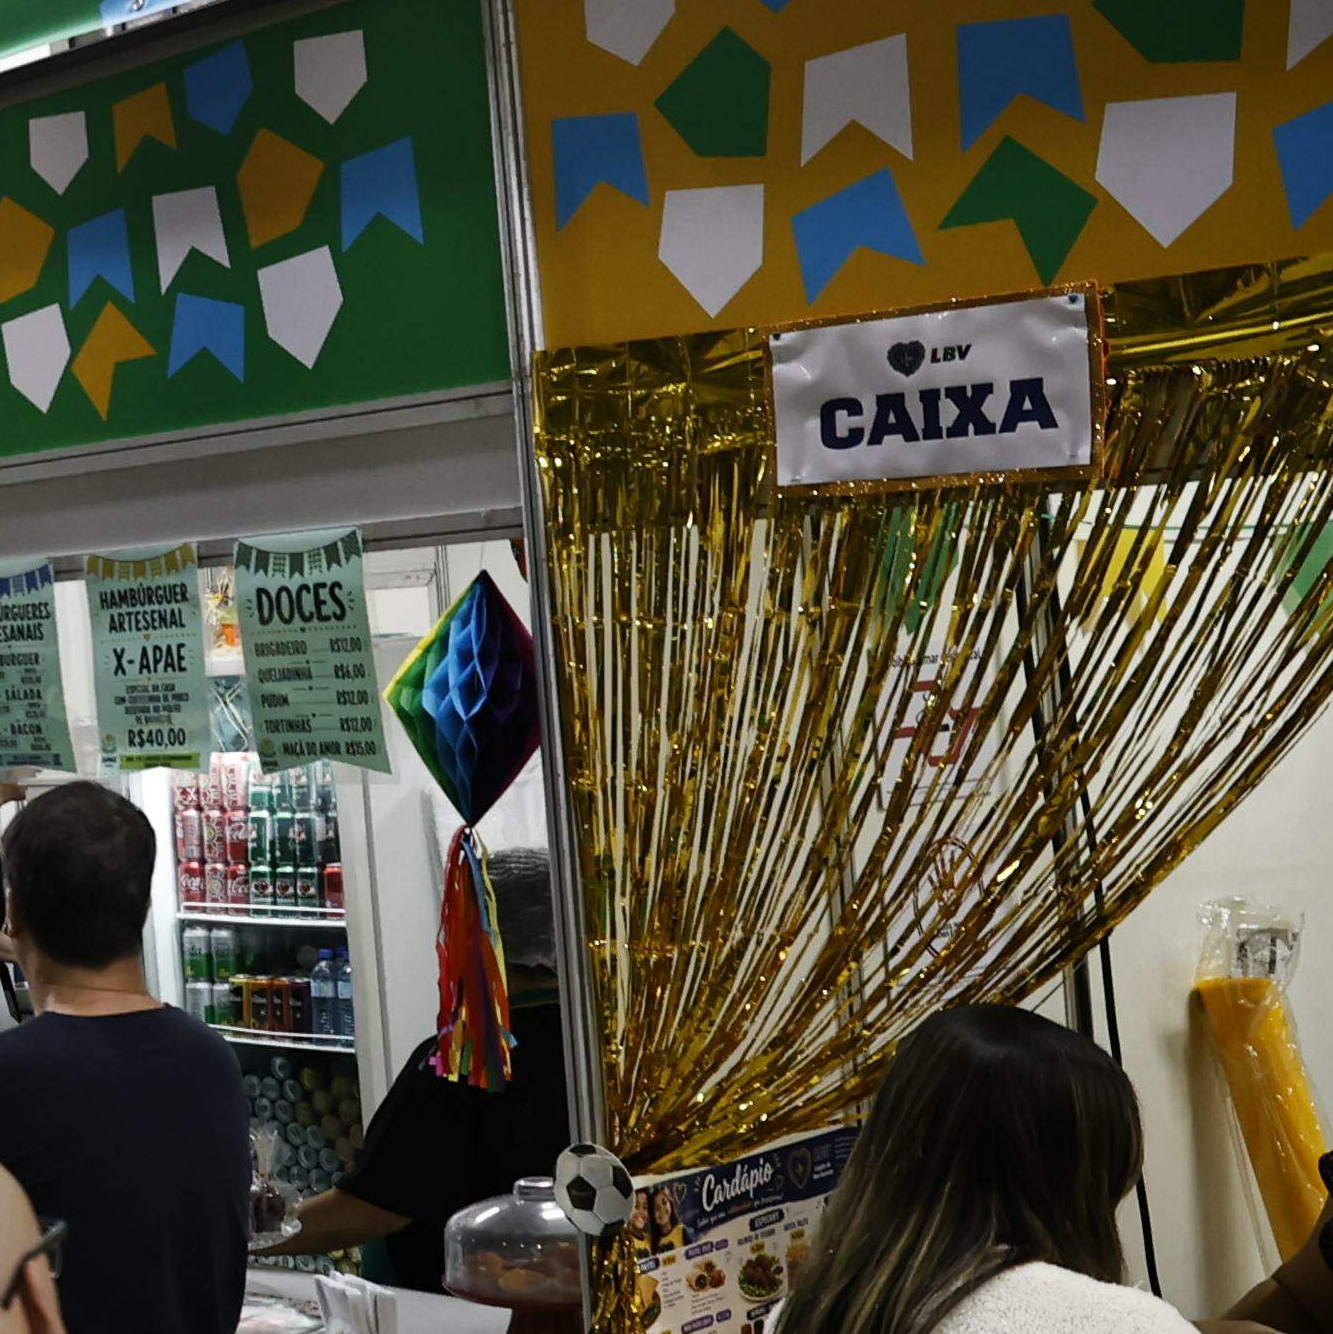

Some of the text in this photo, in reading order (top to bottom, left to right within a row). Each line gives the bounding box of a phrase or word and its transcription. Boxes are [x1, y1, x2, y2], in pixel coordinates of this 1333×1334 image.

[930, 344, 972, 364] LBV
[820, 377, 1059, 449] CAIXA
[100, 583, 189, 610] HAMBÚRGUER
[255, 581, 347, 626] DOCES
[109, 608, 186, 634] ARTESENAL
[254, 640, 308, 657] BRIGADEIRO
[261, 692, 290, 708] PUDIM
[127, 727, 186, 749] R$40,00
[264, 719, 313, 734] TORTINHAS
[702, 1158, 775, 1212] Cardápio
